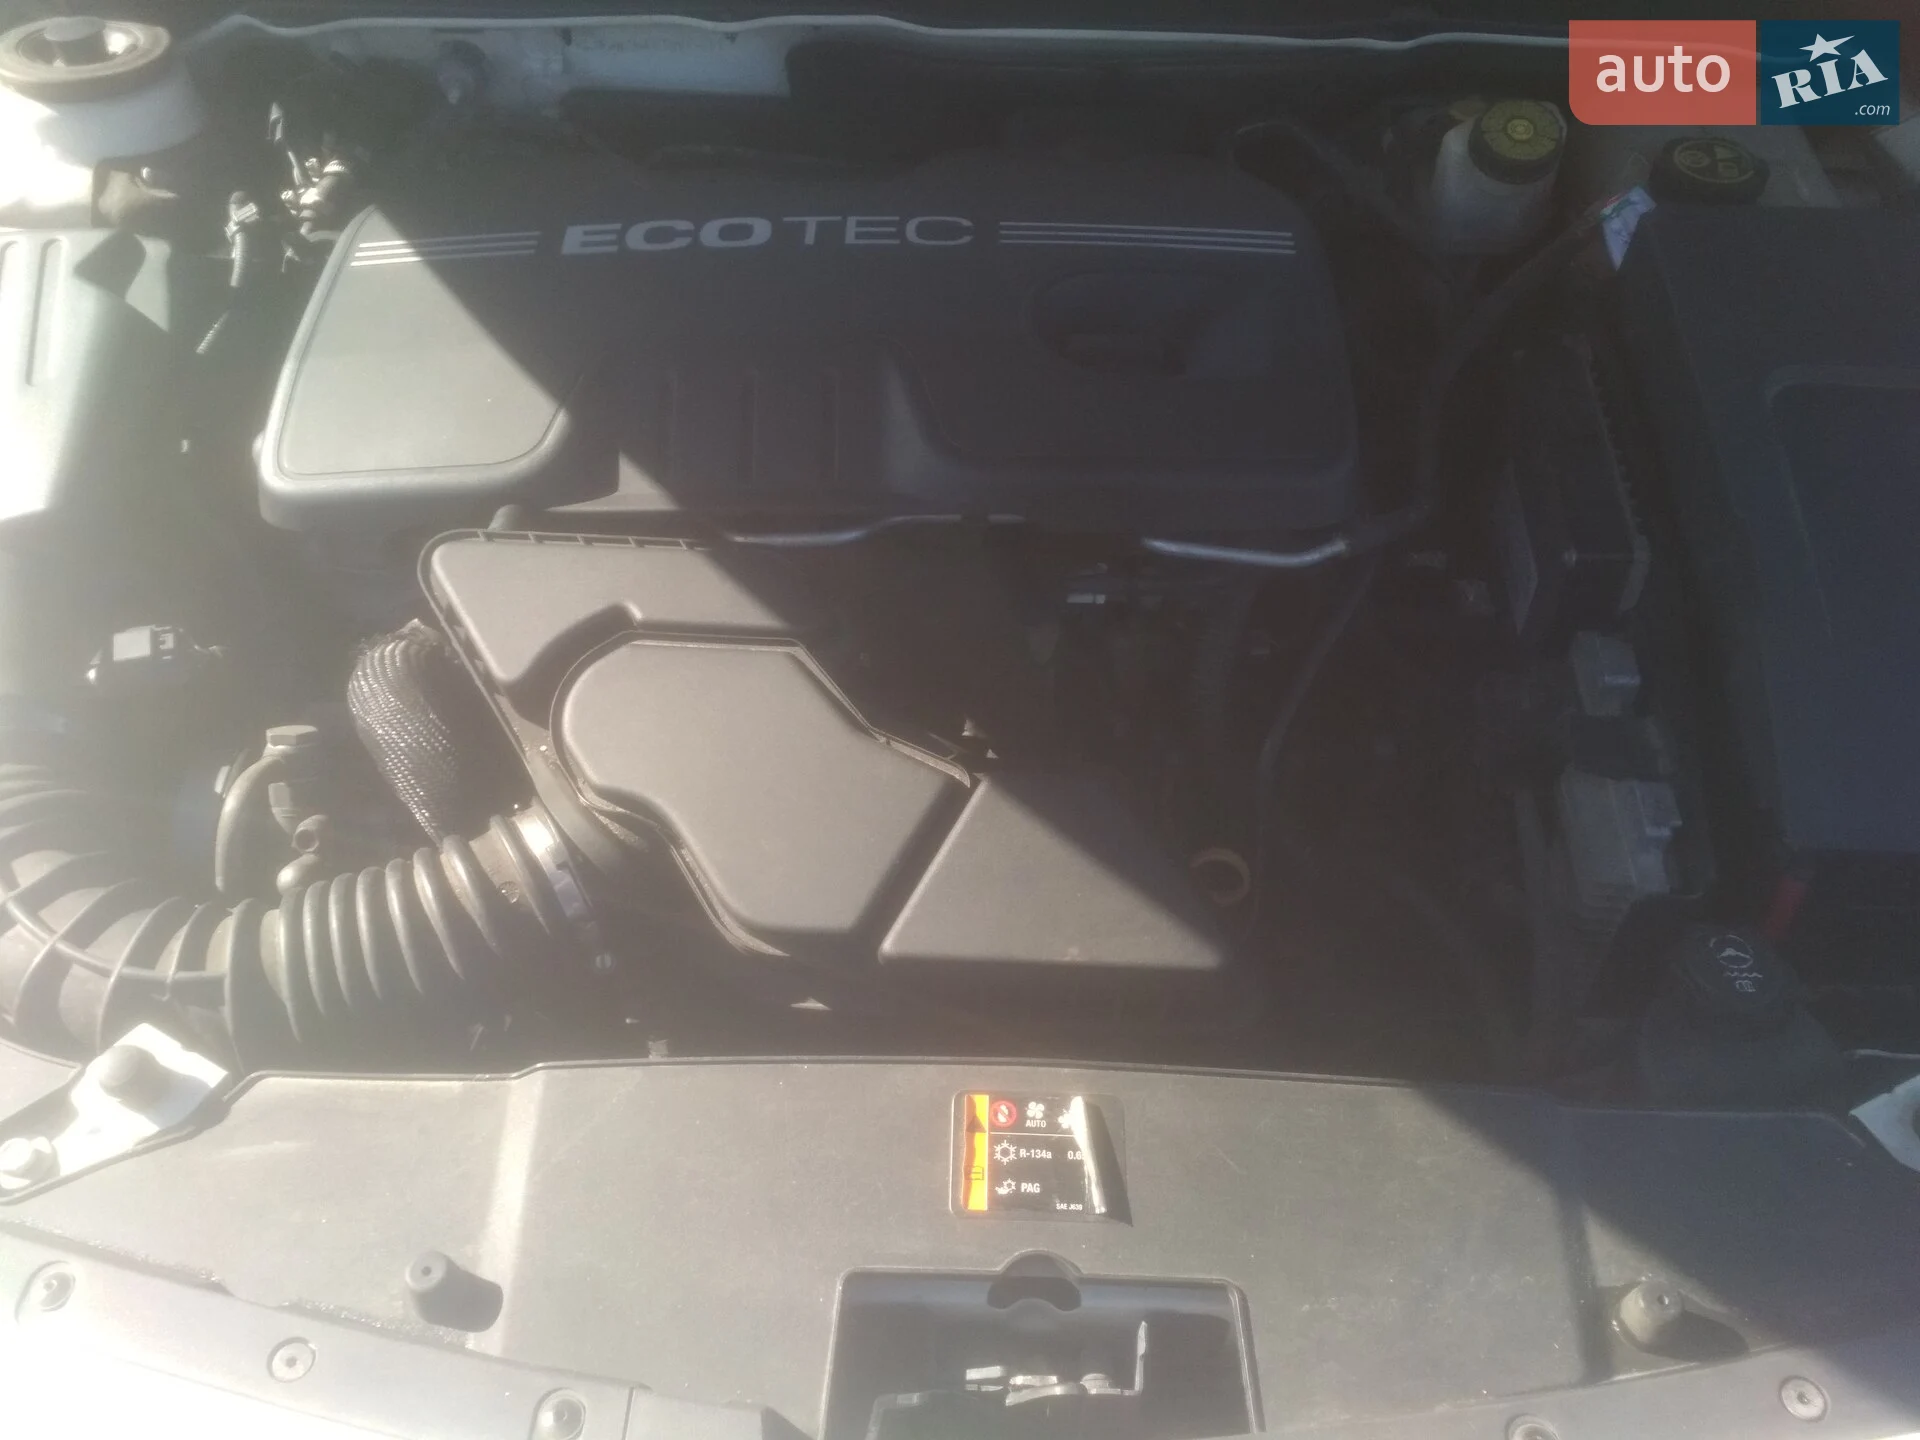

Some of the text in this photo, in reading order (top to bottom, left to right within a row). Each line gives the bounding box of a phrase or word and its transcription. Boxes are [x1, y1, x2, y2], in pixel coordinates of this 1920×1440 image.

[561, 215, 974, 256] ECOTEC
[1025, 1119, 1047, 1128] AUTO
[1019, 1149, 1052, 1159] R-134a
[1020, 1182, 1041, 1194] PAG
